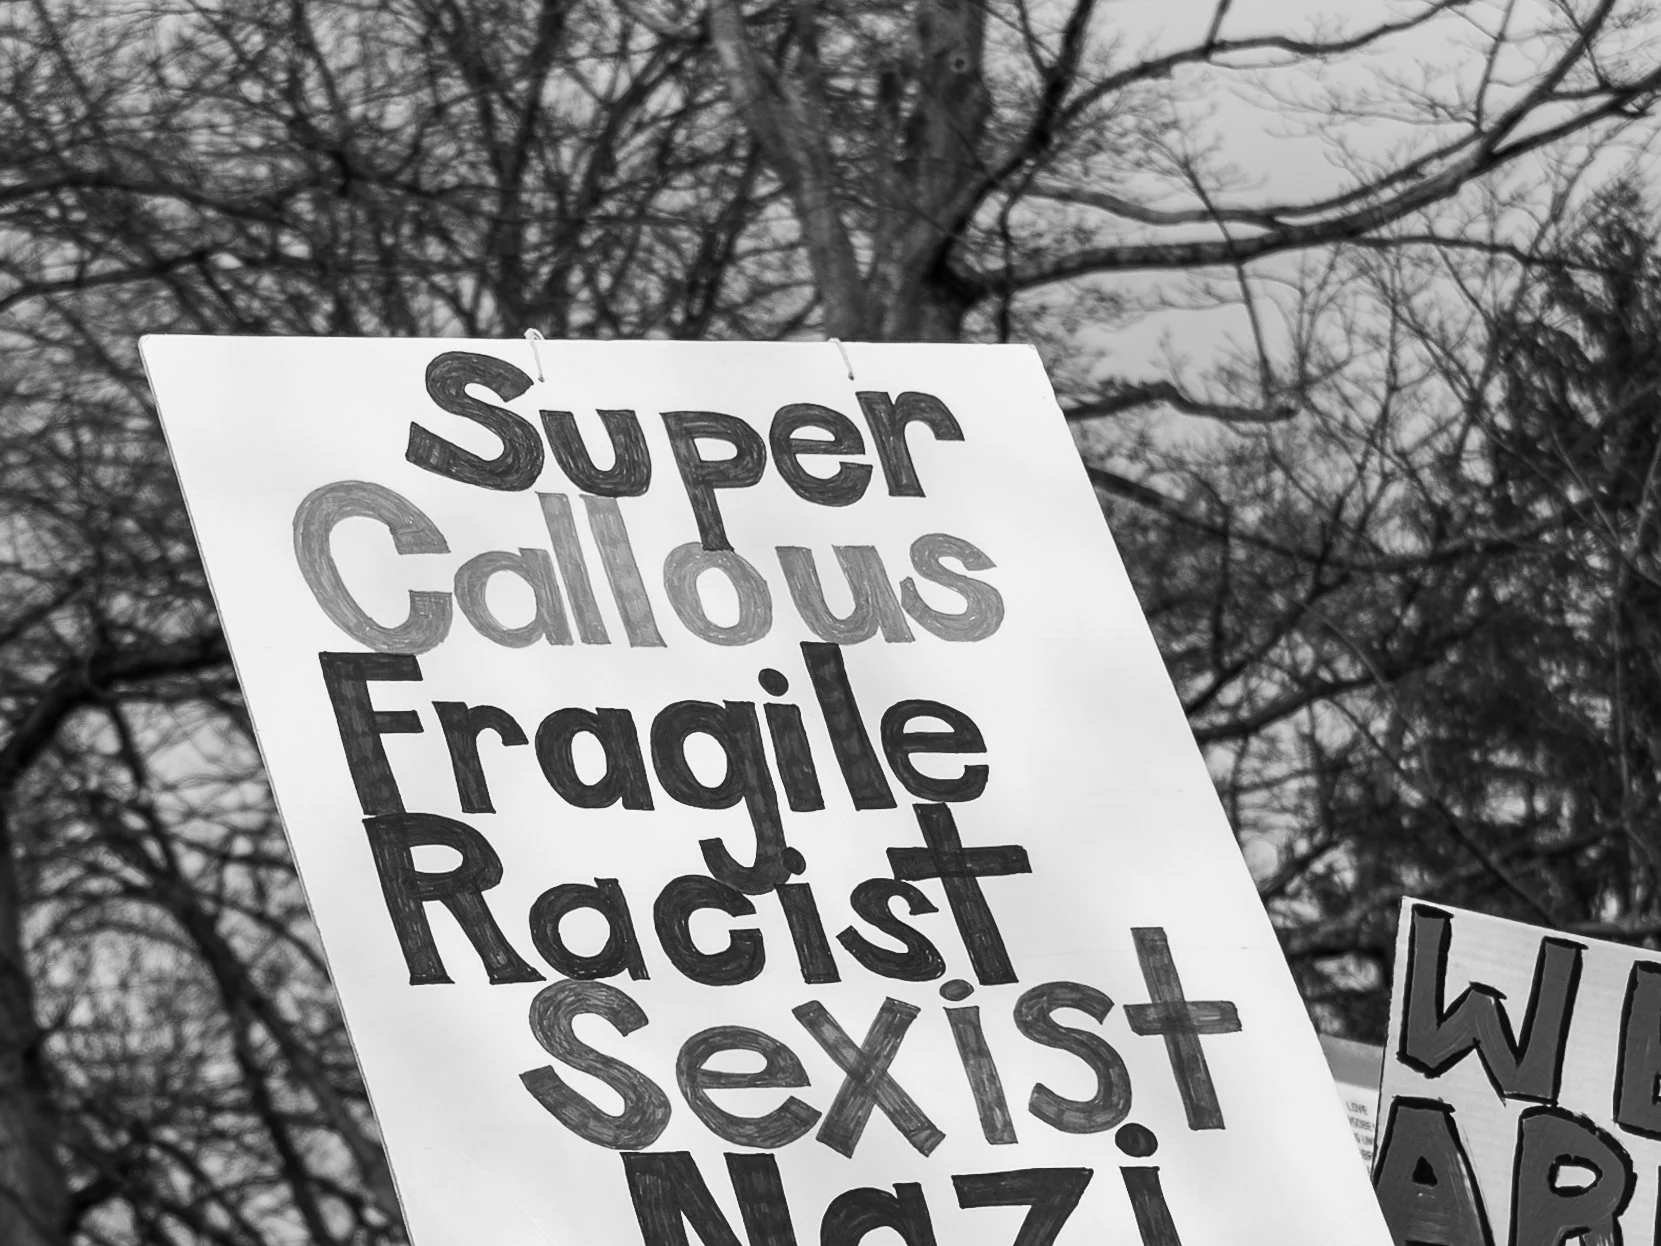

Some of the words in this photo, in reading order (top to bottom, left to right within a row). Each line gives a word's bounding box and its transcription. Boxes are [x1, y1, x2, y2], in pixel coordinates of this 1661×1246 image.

[405, 350, 966, 552] Super
[292, 480, 1005, 655] Callous
[318, 641, 990, 895] Fragile
[362, 802, 1033, 986] Racist
[519, 927, 1243, 1157] Sexist
